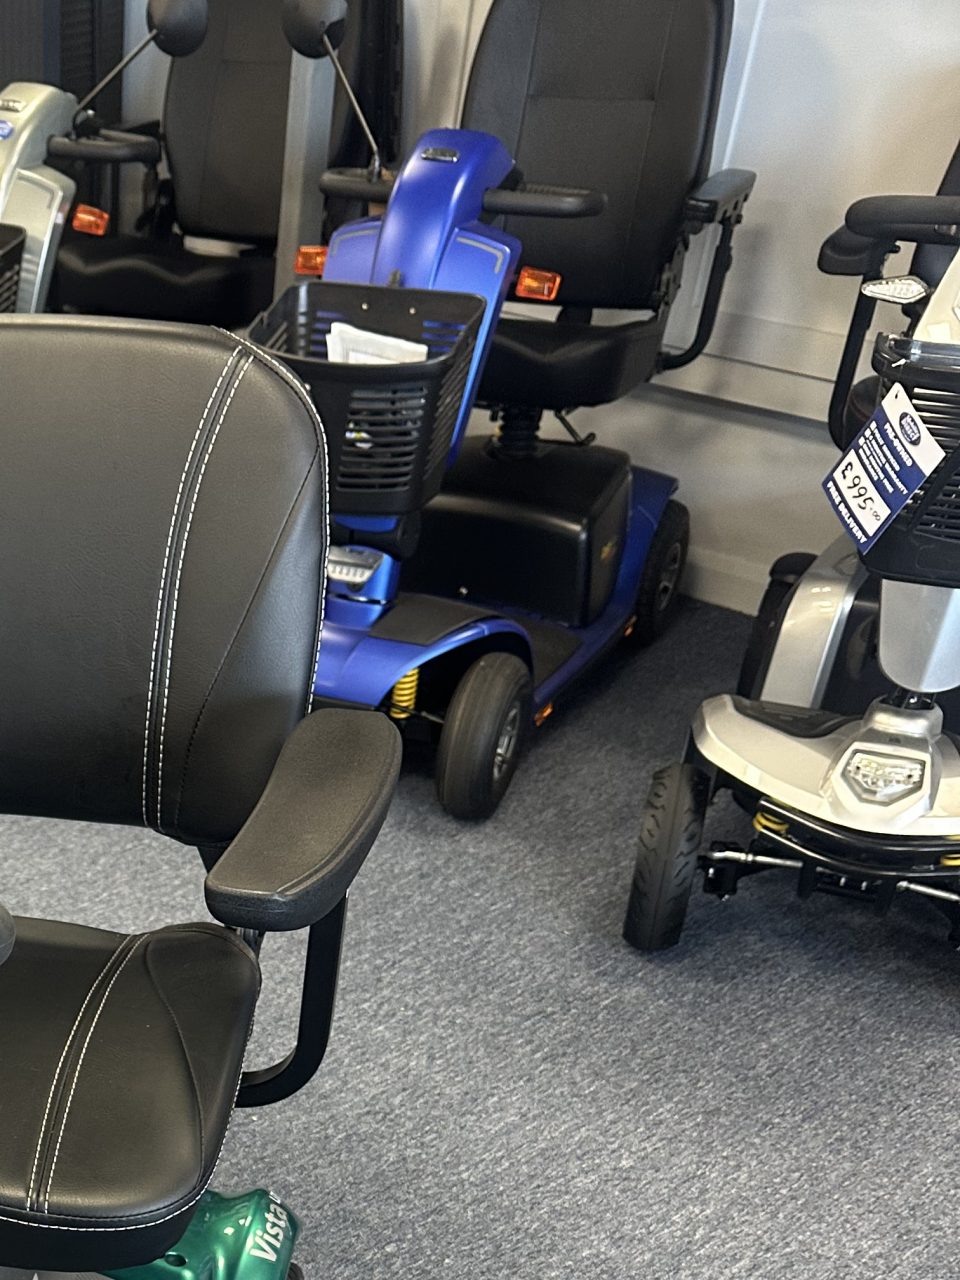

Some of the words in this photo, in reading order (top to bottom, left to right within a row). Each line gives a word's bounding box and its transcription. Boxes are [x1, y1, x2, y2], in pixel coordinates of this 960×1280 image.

[883, 422, 913, 467] PRE-OWNED
[901, 418, 918, 441] DIRECT
[826, 480, 844, 509] FREE
[837, 504, 868, 544] DELIVERY
[249, 1203, 288, 1262] Vista
